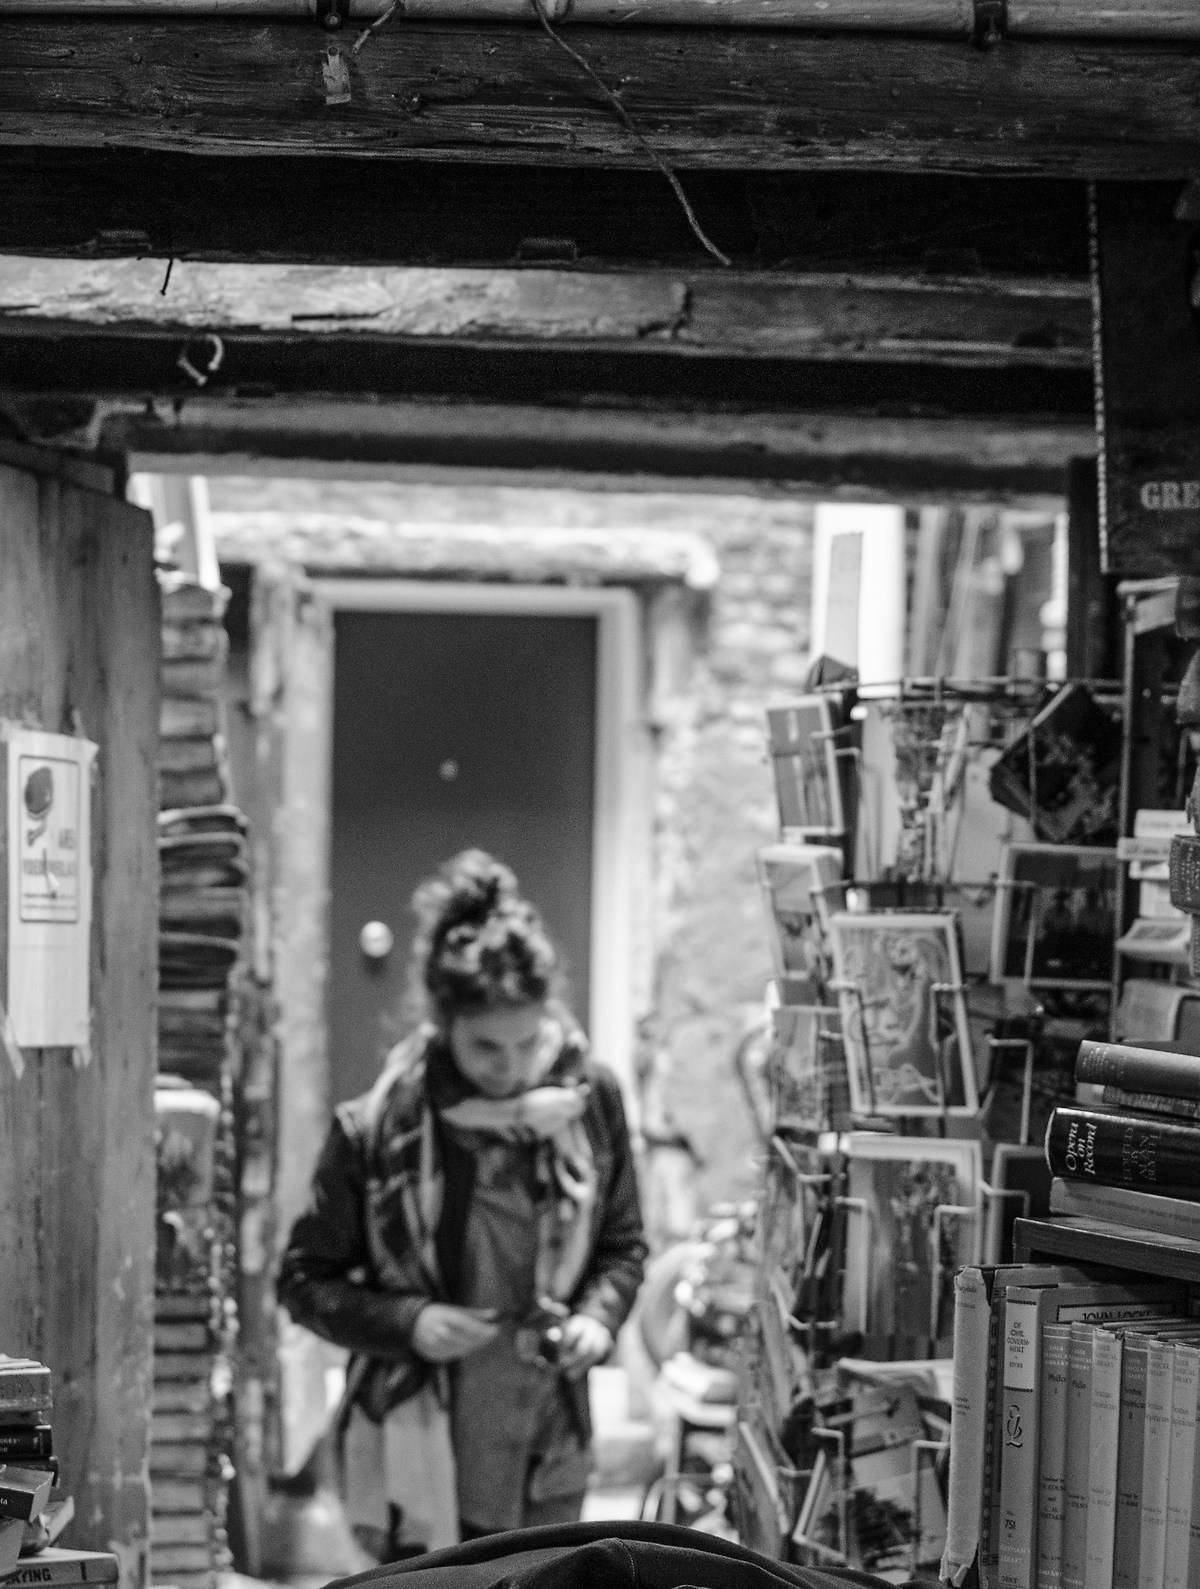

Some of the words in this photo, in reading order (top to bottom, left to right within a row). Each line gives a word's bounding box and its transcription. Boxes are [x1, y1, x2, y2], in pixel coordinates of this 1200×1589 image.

[1066, 1123, 1079, 1170] Opera
[1079, 1139, 1086, 1157] on
[1085, 1123, 1097, 1174] Record
